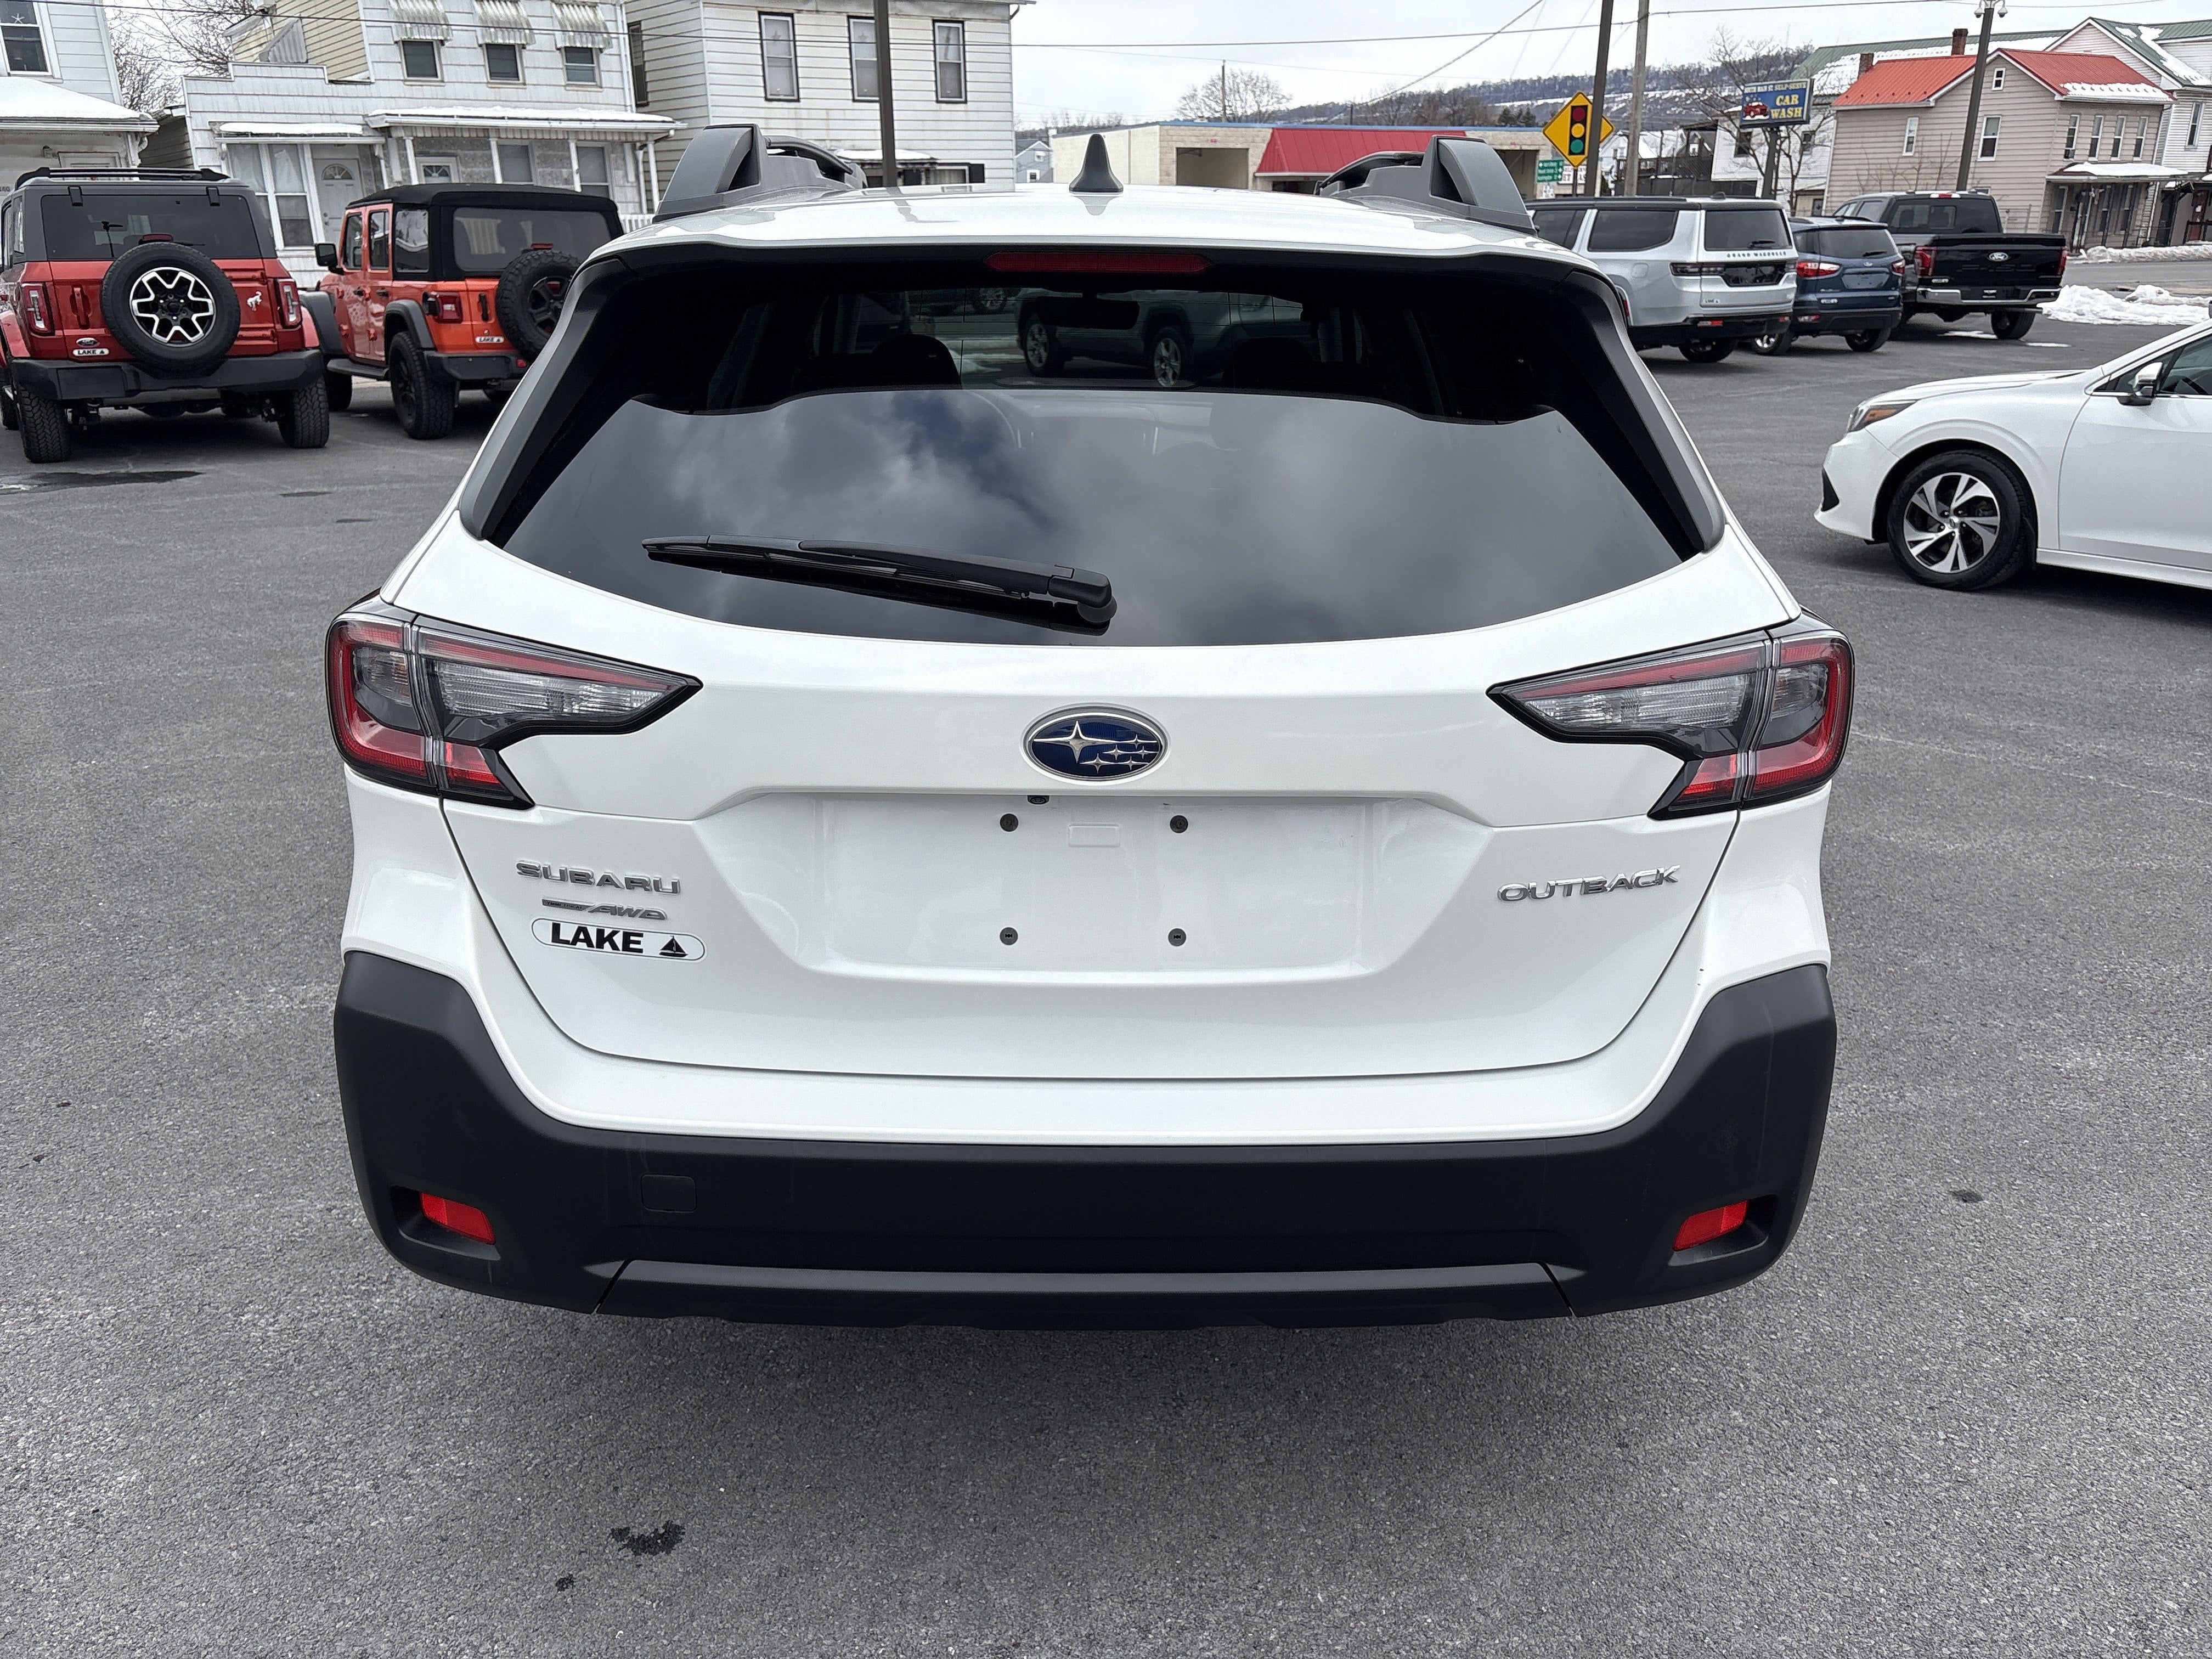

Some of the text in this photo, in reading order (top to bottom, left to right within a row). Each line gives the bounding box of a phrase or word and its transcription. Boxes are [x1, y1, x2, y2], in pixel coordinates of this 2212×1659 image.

[1776, 94, 1799, 106] CAR
[1770, 107, 1803, 119] WASH
[516, 860, 680, 894] SUBARU
[1497, 865, 1680, 901] OUTBACK
[588, 903, 668, 921] AWD
[551, 922, 644, 953] LAKE
